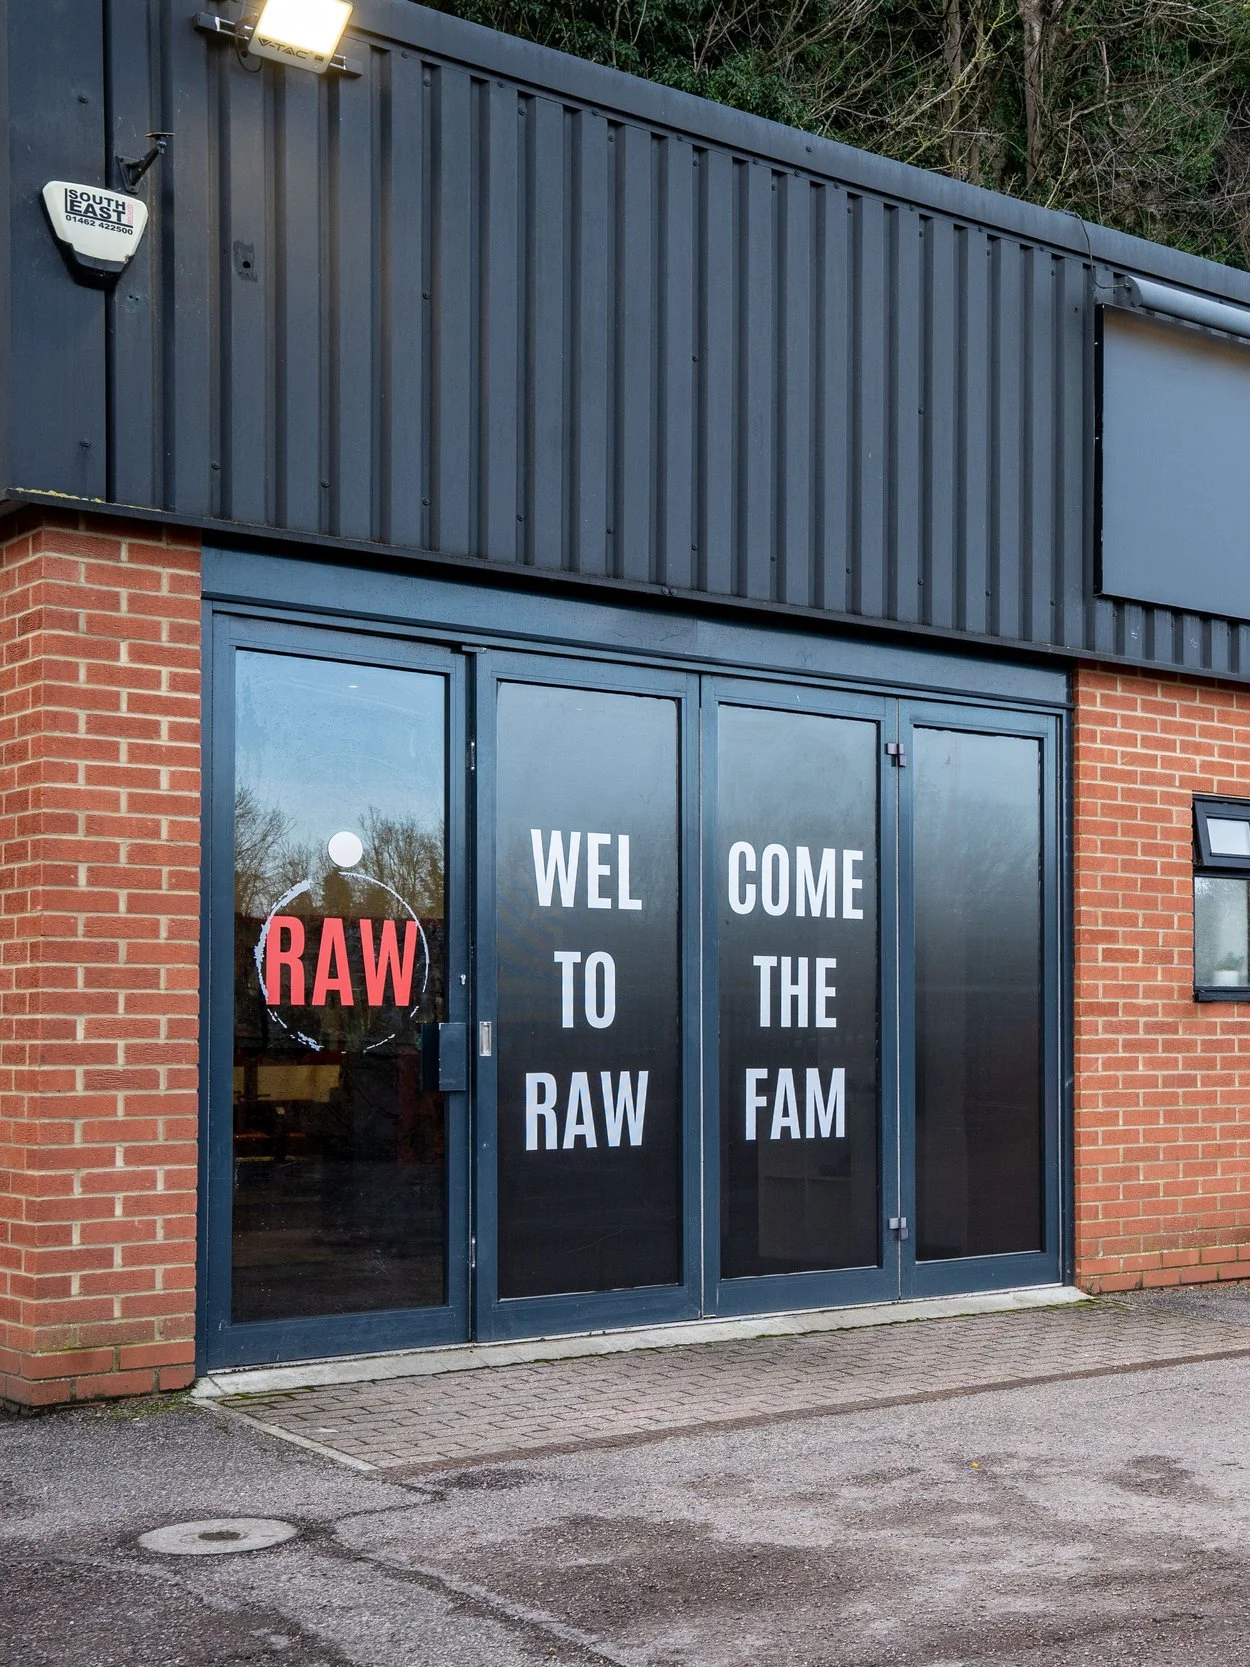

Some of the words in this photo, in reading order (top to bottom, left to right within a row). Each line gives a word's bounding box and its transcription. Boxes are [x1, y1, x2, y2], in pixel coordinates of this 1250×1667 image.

[258, 37, 308, 59] V-TAC
[65, 215, 96, 227] 01462
[98, 222, 133, 235] 422500
[68, 189, 125, 211] SOUTH
[69, 199, 125, 222] EAST
[531, 829, 642, 910] WEL
[728, 841, 864, 919] COME
[266, 915, 418, 1007] RAW
[553, 951, 616, 1028] TO
[753, 955, 837, 1028] THE
[525, 1070, 649, 1151] RAW
[745, 1068, 846, 1141] FAM
